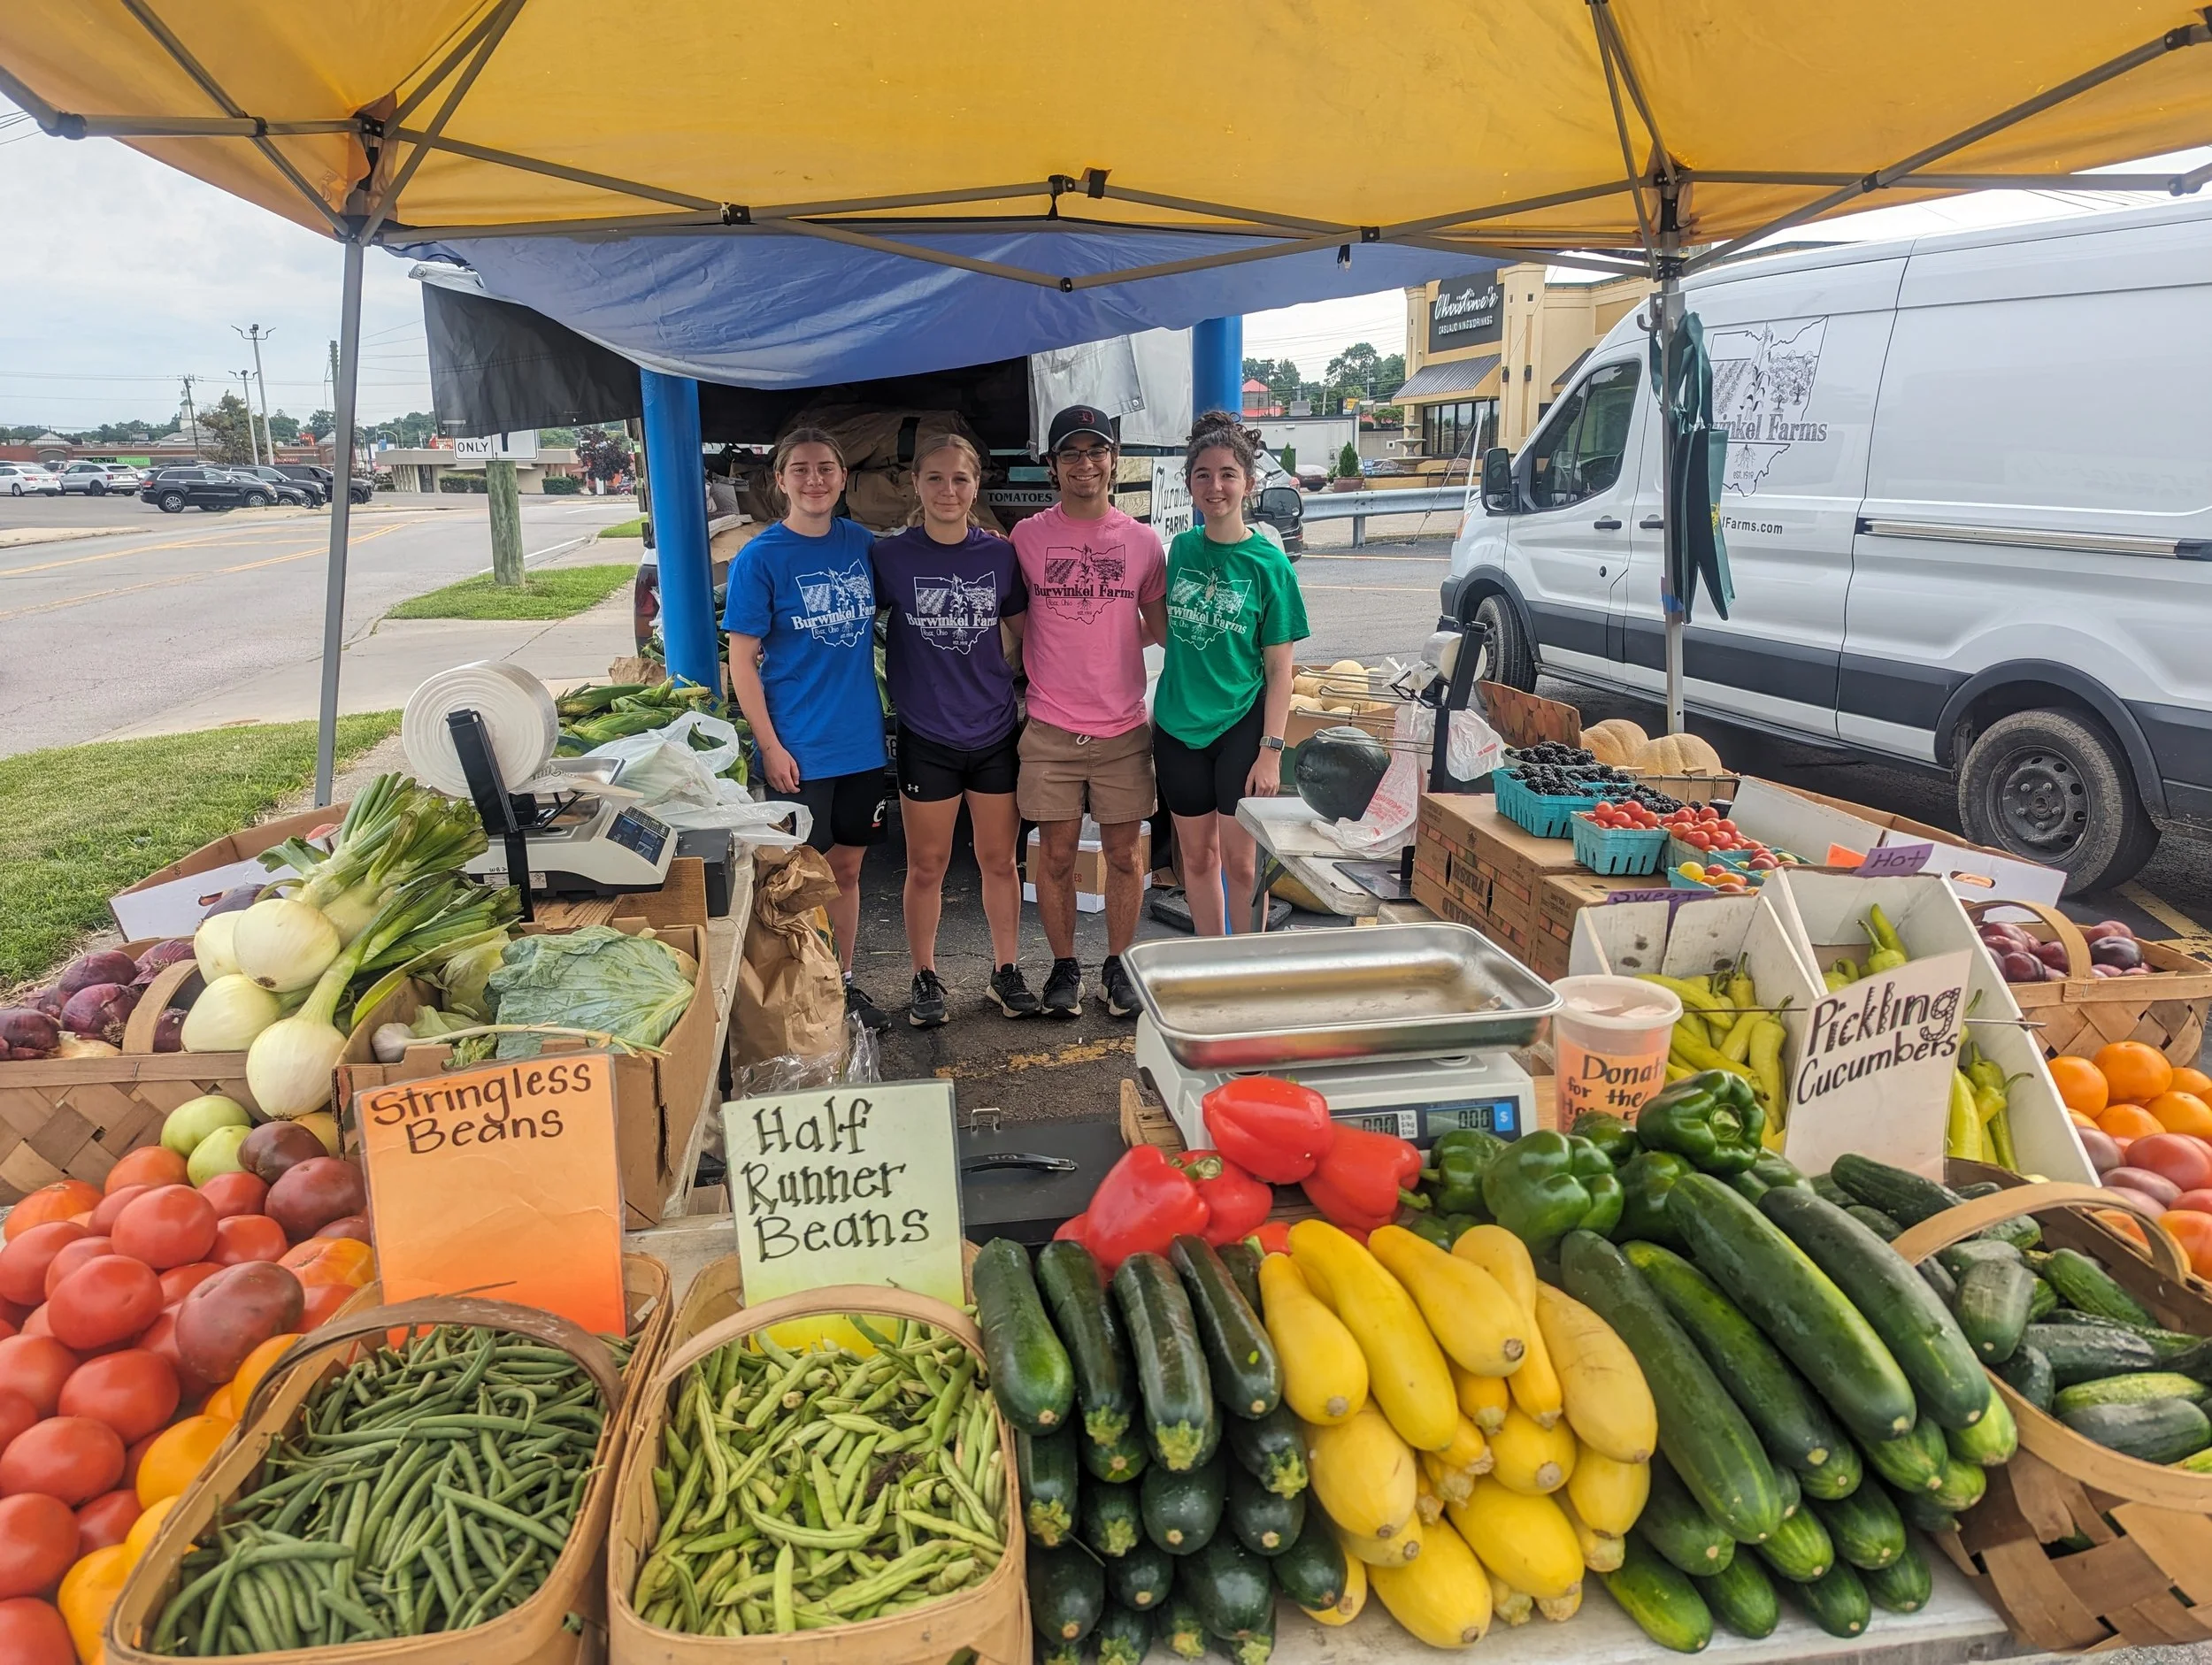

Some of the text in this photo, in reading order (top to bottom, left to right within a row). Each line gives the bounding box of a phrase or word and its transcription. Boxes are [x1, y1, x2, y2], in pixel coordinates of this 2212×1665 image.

[1434, 286, 1499, 320] Christine's
[1439, 323, 1454, 335] CASUAL
[1766, 413, 1828, 441] Farms
[457, 441, 488, 453] ONLY
[987, 492, 1053, 503] TOMATOES
[1164, 513, 1189, 537] FARMS
[1722, 516, 1783, 535] lFarms.com
[1033, 583, 1135, 599] Burwinkel Farms
[791, 605, 856, 630] Burwinkel
[905, 612, 970, 627] Burwinkel
[1213, 612, 1248, 634] Farms
[1870, 850, 1926, 869] Hot
[1613, 891, 1701, 903] Sweet
[1807, 981, 1962, 1057] Pickling
[1582, 1055, 1663, 1086] Donat
[1797, 1032, 1959, 1105] Cucumbers
[370, 1063, 592, 1126] Stringless
[1567, 1076, 1592, 1098] for
[1605, 1088, 1647, 1108] the
[752, 1095, 873, 1155] Half
[1500, 1110, 1509, 1124] $
[405, 1109, 564, 1155] Beans
[741, 1161, 907, 1216] Runner
[753, 1208, 930, 1263] Beans
